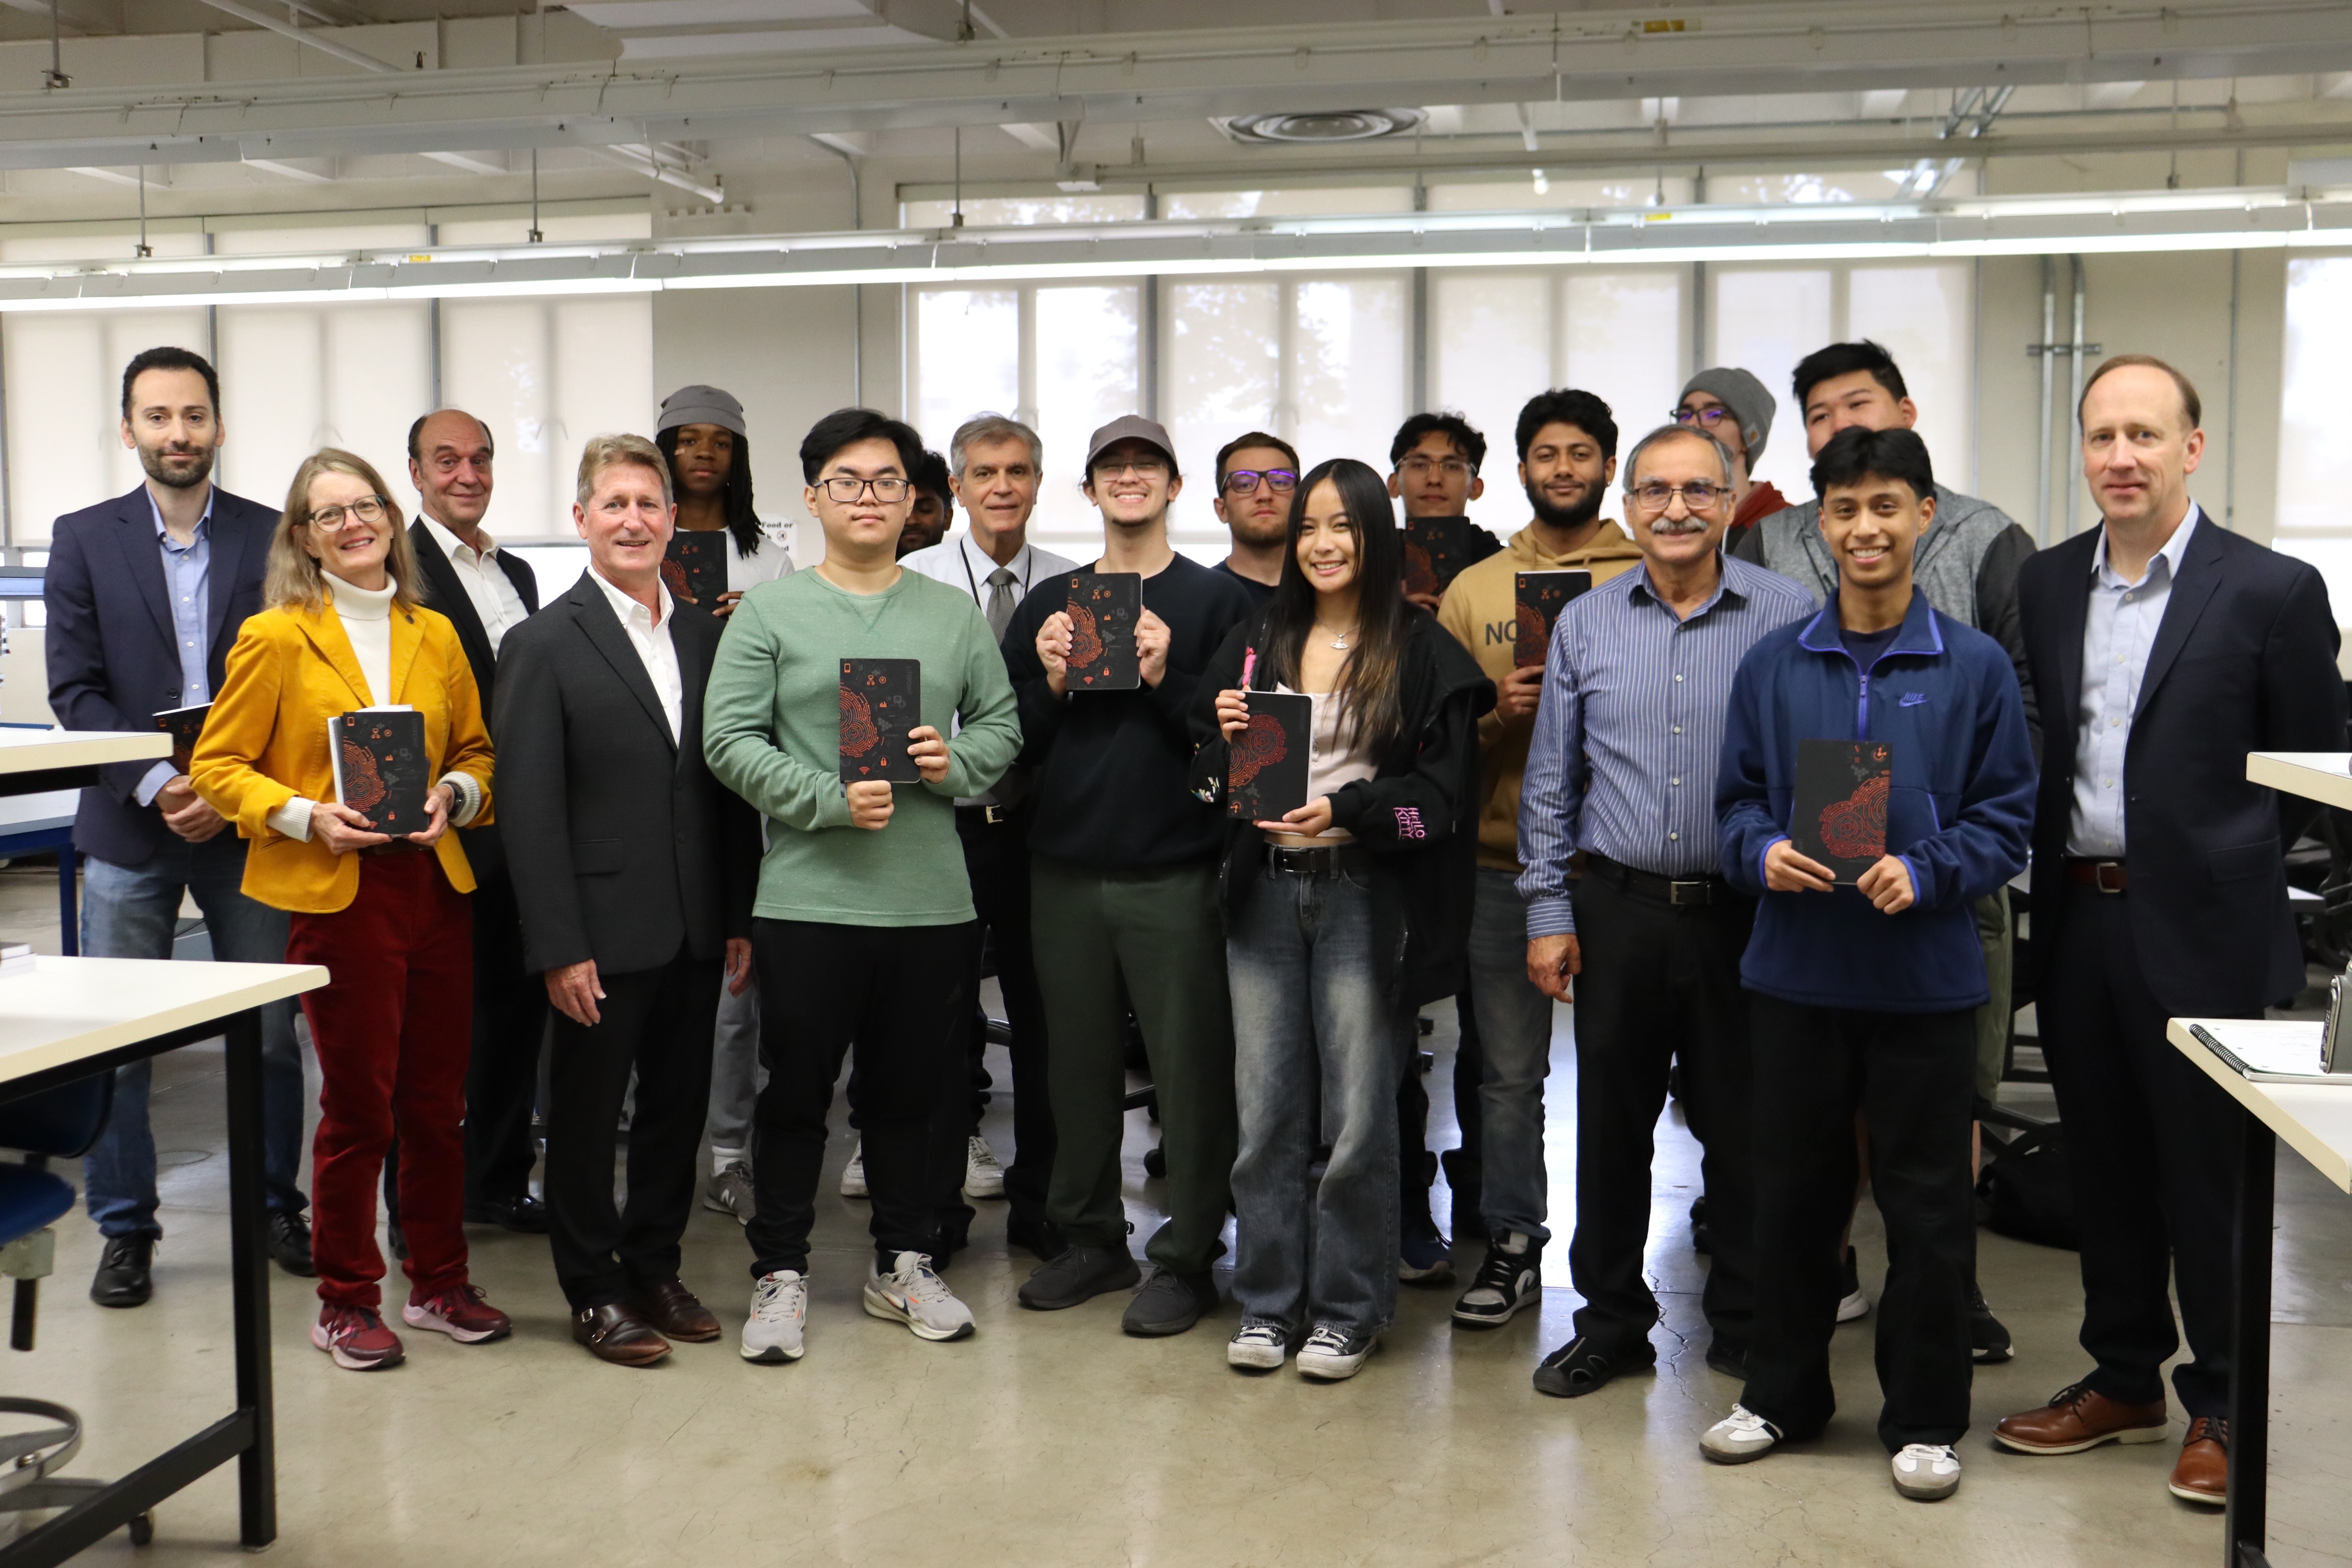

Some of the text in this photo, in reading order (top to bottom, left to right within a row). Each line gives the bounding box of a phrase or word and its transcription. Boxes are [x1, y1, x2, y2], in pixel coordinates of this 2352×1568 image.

[1904, 692, 1924, 702] NIKE
[1393, 807, 1414, 838] KITTY
[1408, 808, 1425, 838] HELLO
